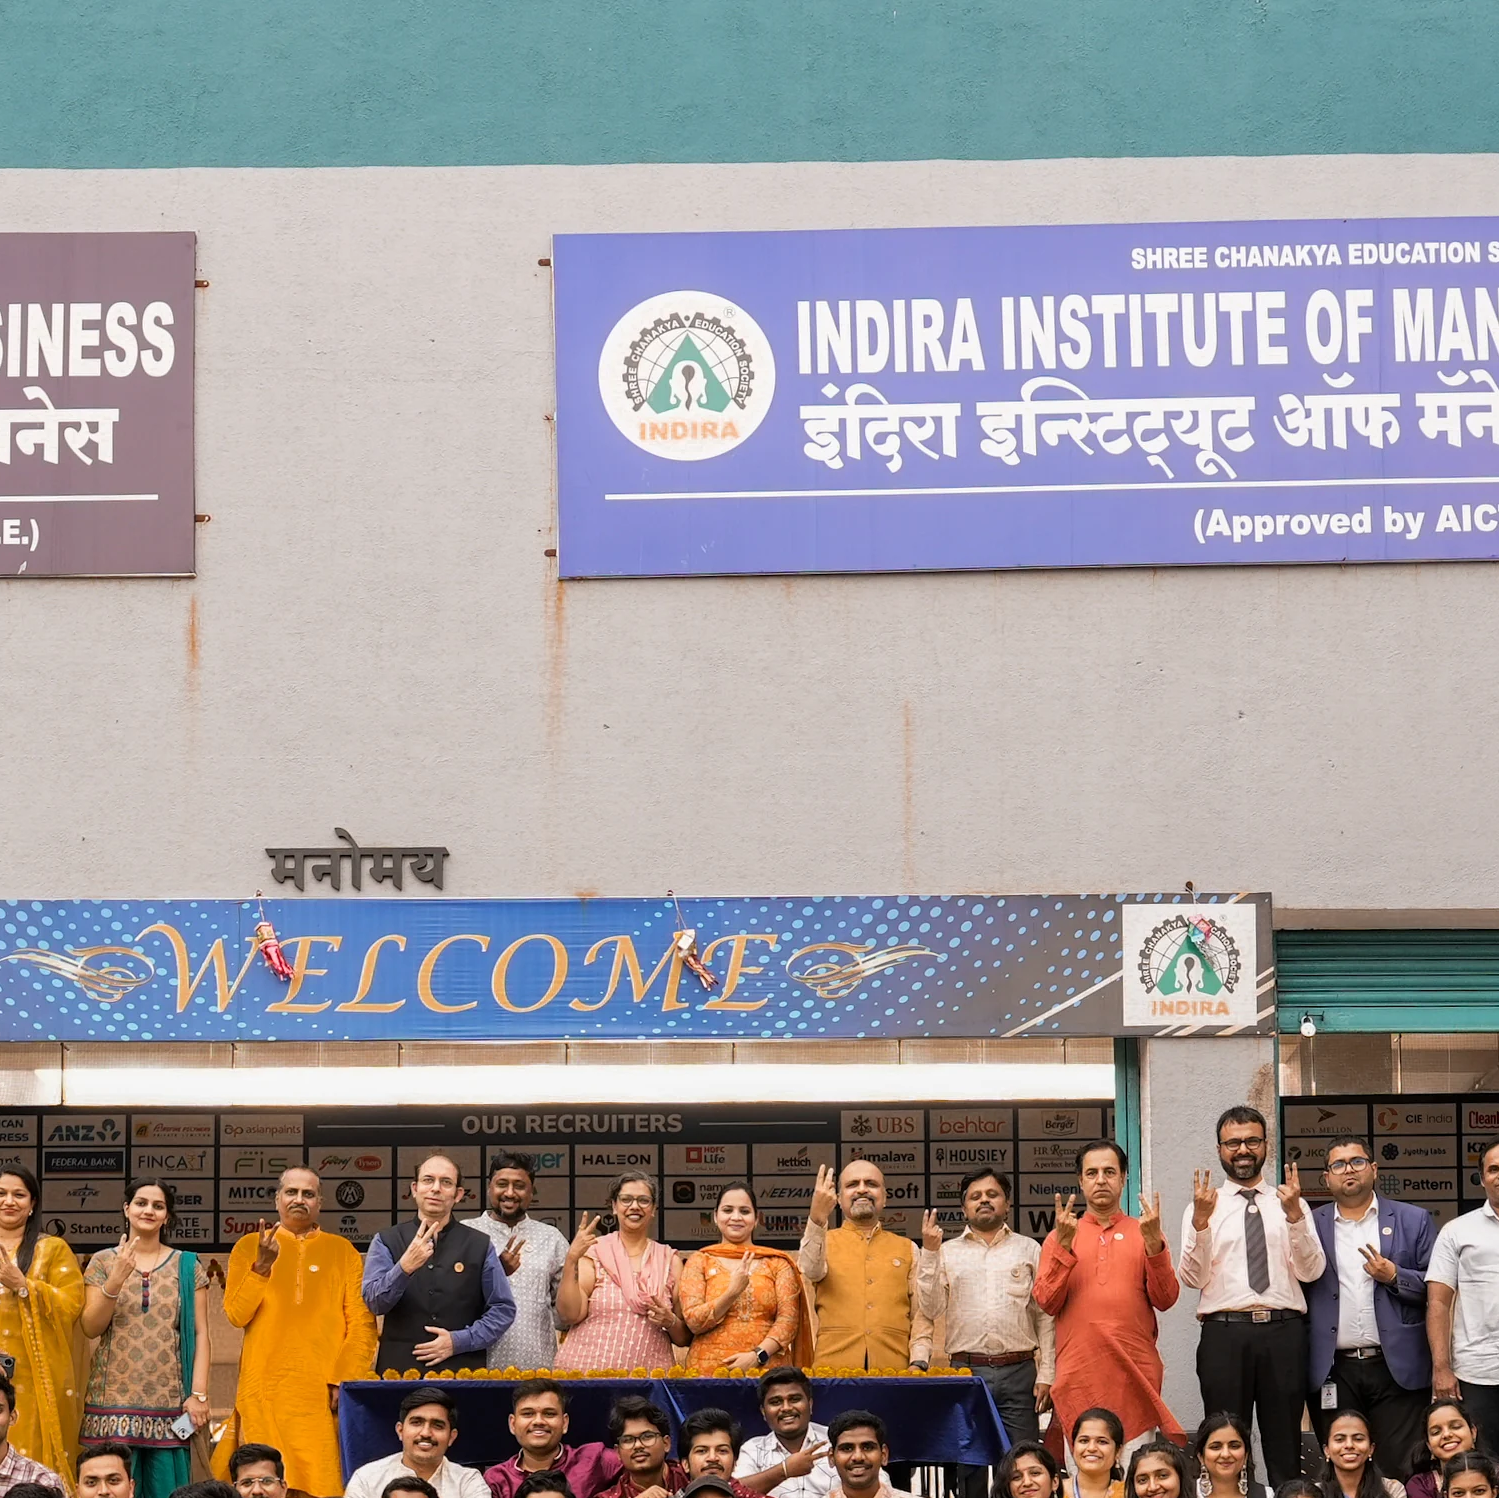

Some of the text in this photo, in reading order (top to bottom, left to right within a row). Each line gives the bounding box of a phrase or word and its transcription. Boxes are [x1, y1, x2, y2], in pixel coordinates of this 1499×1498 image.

[1132, 247, 1207, 269] SHREE
[1215, 245, 1342, 267] CHANAKYA
[1349, 242, 1480, 264] EDUCATION
[798, 298, 985, 373] INDIRA
[1002, 292, 1288, 369] INSTITUTE
[1306, 290, 1373, 364] OF
[800, 383, 961, 472] इंदिरा
[1274, 372, 1400, 450] ऑफ
[639, 420, 740, 441] INDIRA
[1195, 507, 1371, 543] (Approved
[1384, 506, 1424, 539] by
[265, 827, 449, 892] मनोमय
[135, 923, 778, 1013] WELCOME
[1151, 1000, 1230, 1016] INDIRA
[461, 1113, 683, 1134] OUR RECRUITERS
[876, 1116, 915, 1134] UBS
[939, 1115, 1006, 1134] behtar
[1405, 1114, 1453, 1124] CIE India
[47, 1125, 96, 1142] ANZ
[245, 1123, 301, 1138] asianpaints
[703, 1146, 725, 1154] HDFC
[950, 1149, 1007, 1162] HOUSIEY
[1033, 1146, 1049, 1156] HR
[51, 1157, 117, 1167] FEDERAL BANK
[582, 1154, 651, 1166] HALEON
[703, 1154, 726, 1165] Life
[777, 1157, 811, 1167] Hettich
[1404, 1178, 1453, 1190] Pattern
[70, 1223, 121, 1235] Stantec
